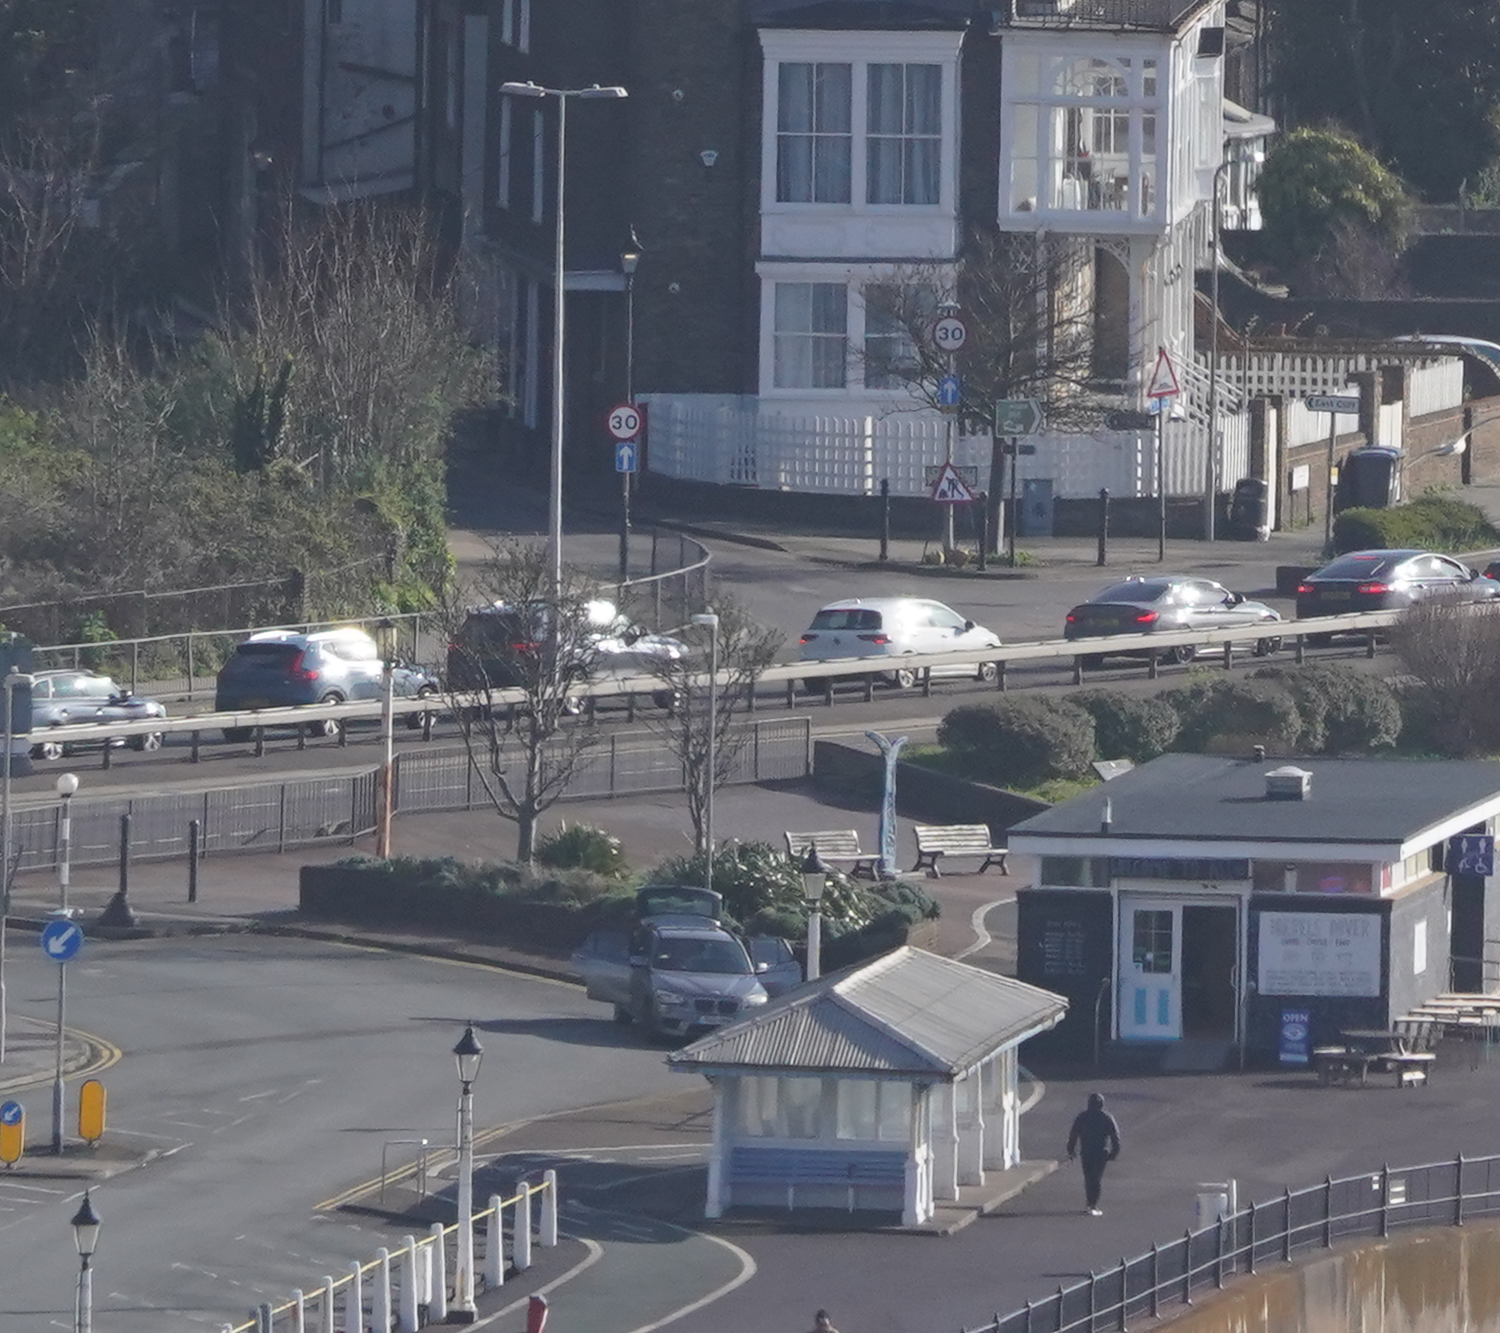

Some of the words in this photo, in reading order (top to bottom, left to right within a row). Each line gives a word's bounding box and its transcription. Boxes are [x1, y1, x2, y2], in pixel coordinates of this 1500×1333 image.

[938, 327, 963, 341] 30
[1315, 399, 1333, 408] East
[612, 414, 638, 430] 30
[1282, 1013, 1309, 1023] OPEN
